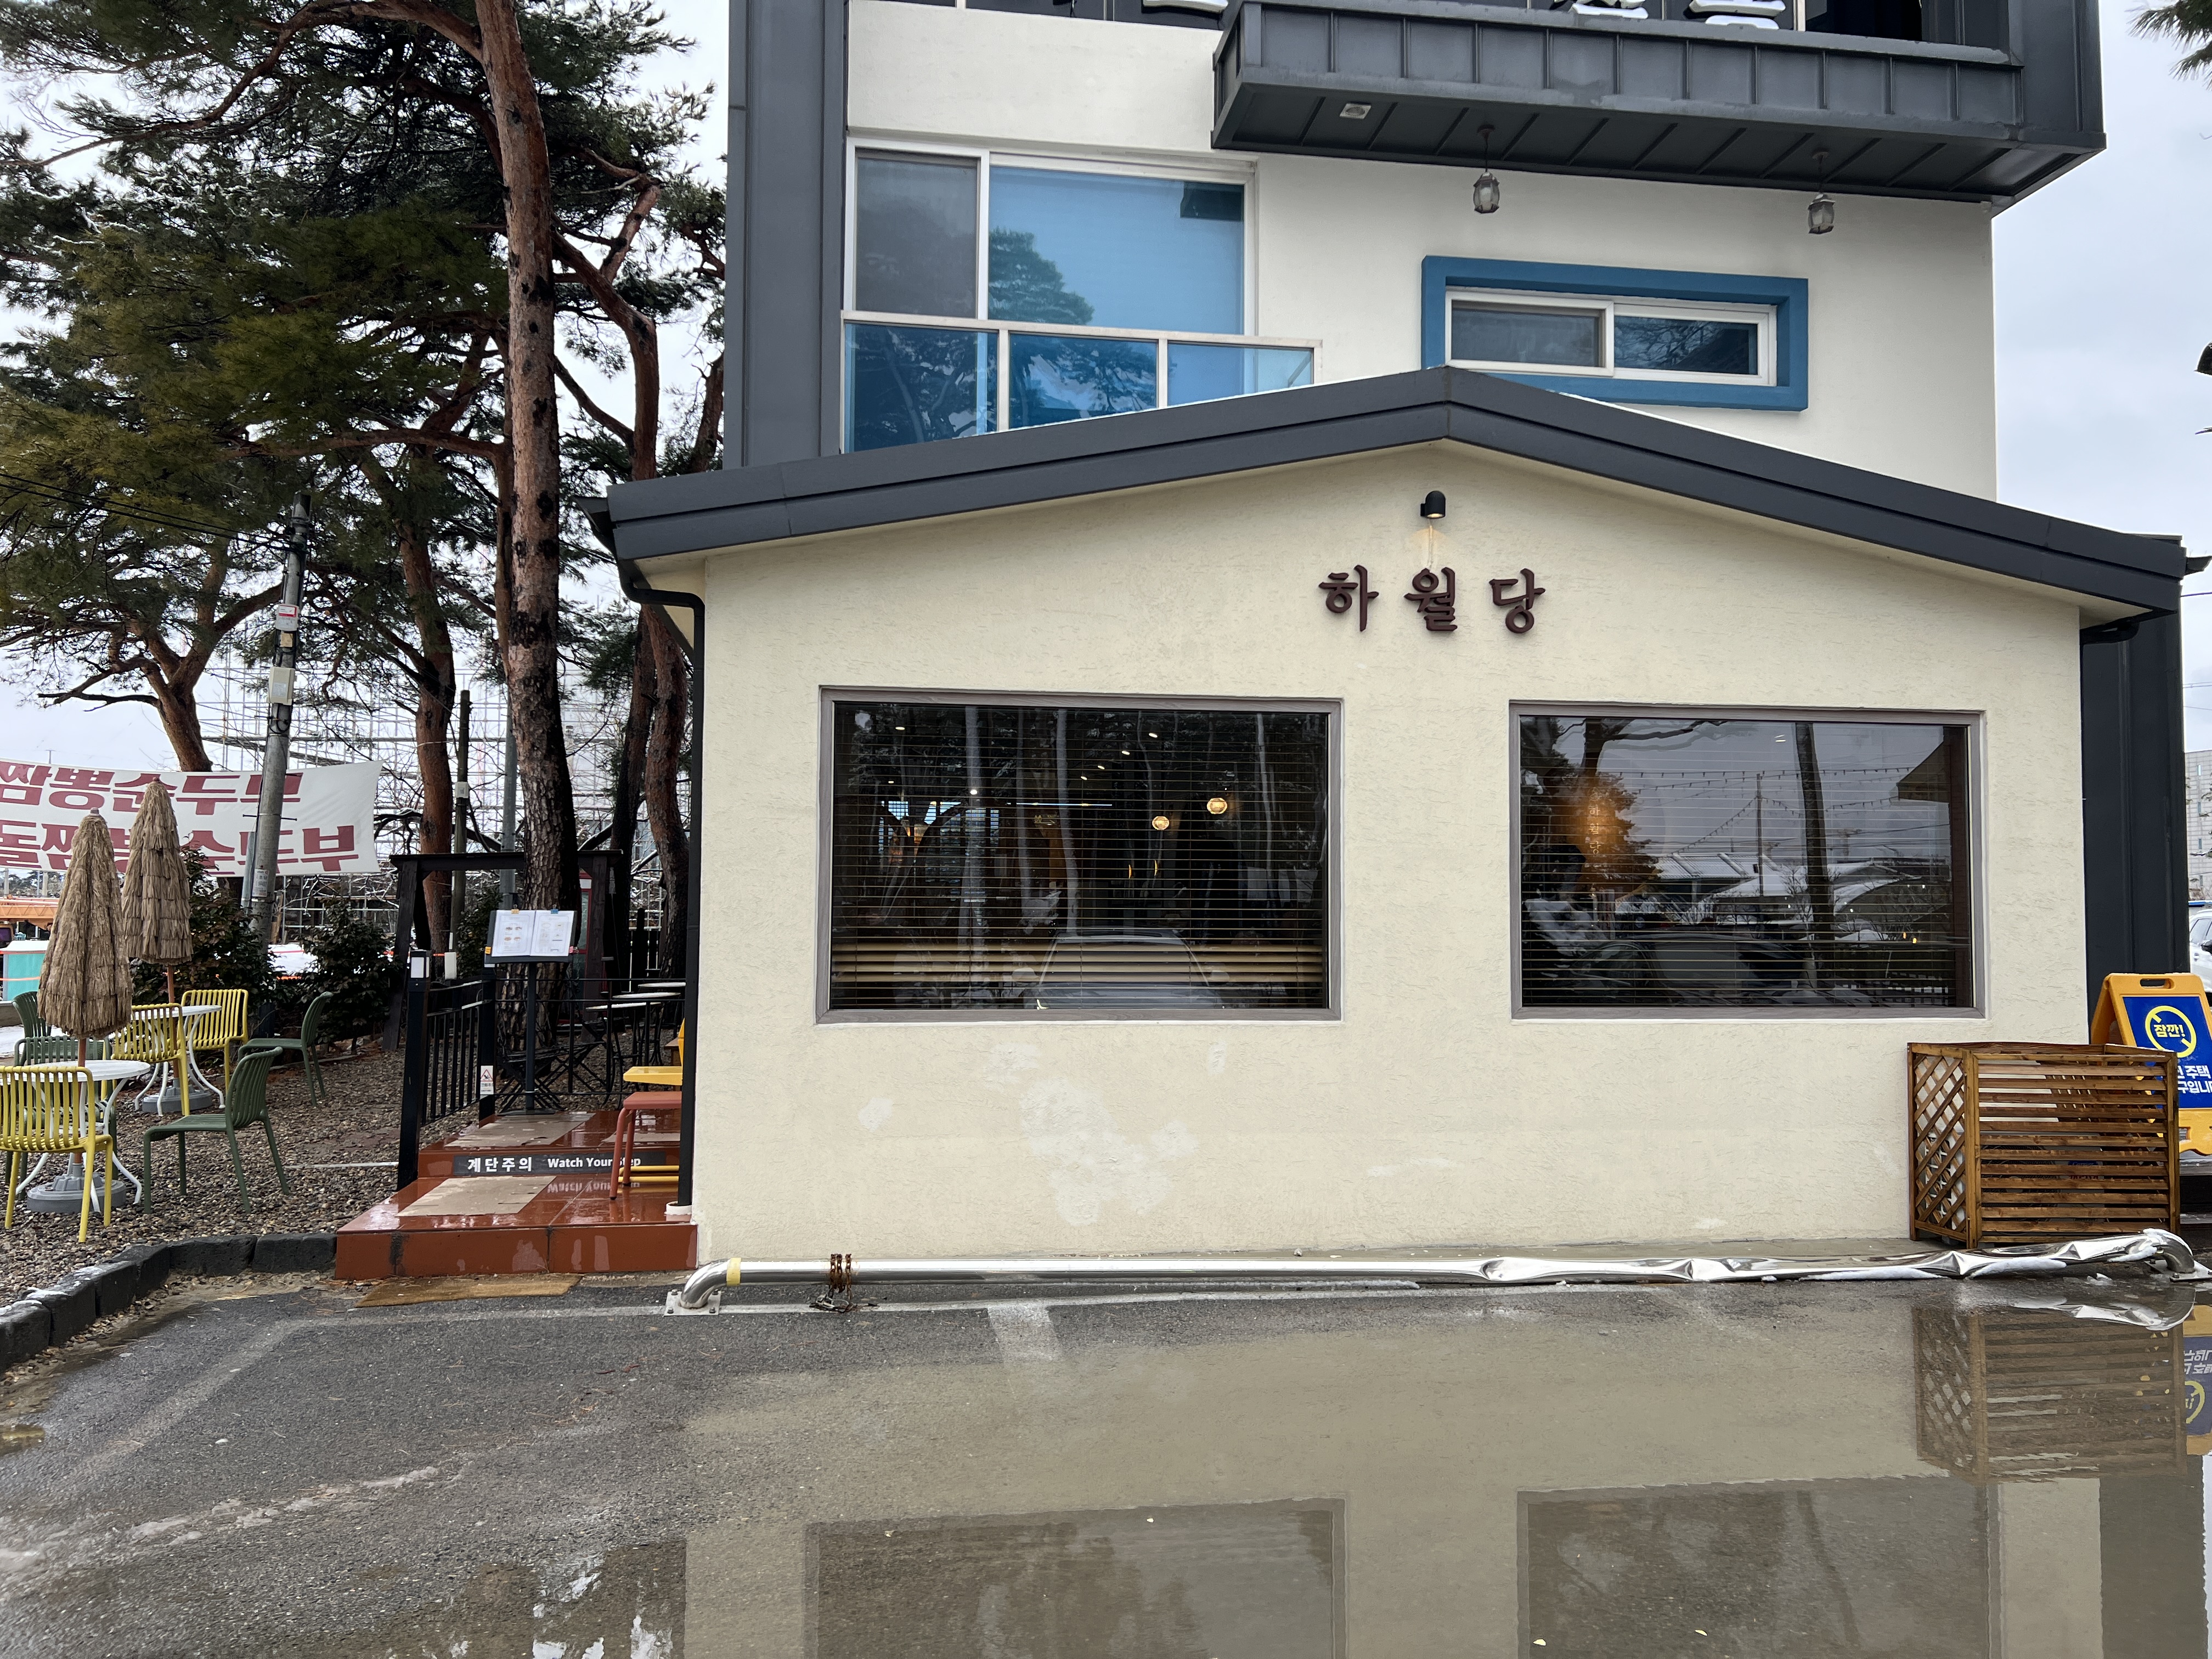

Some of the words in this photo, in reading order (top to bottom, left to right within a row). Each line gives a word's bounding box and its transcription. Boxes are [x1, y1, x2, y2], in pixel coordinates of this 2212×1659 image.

[1318, 565, 1545, 633] 하월당
[1588, 805, 1601, 855] 하월당
[2154, 1024, 2186, 1037] 잠깐!
[2185, 1065, 2211, 1079] 주택
[467, 1156, 532, 1172] 계단주의
[548, 1158, 583, 1167] Watch
[586, 1158, 613, 1167] Your
